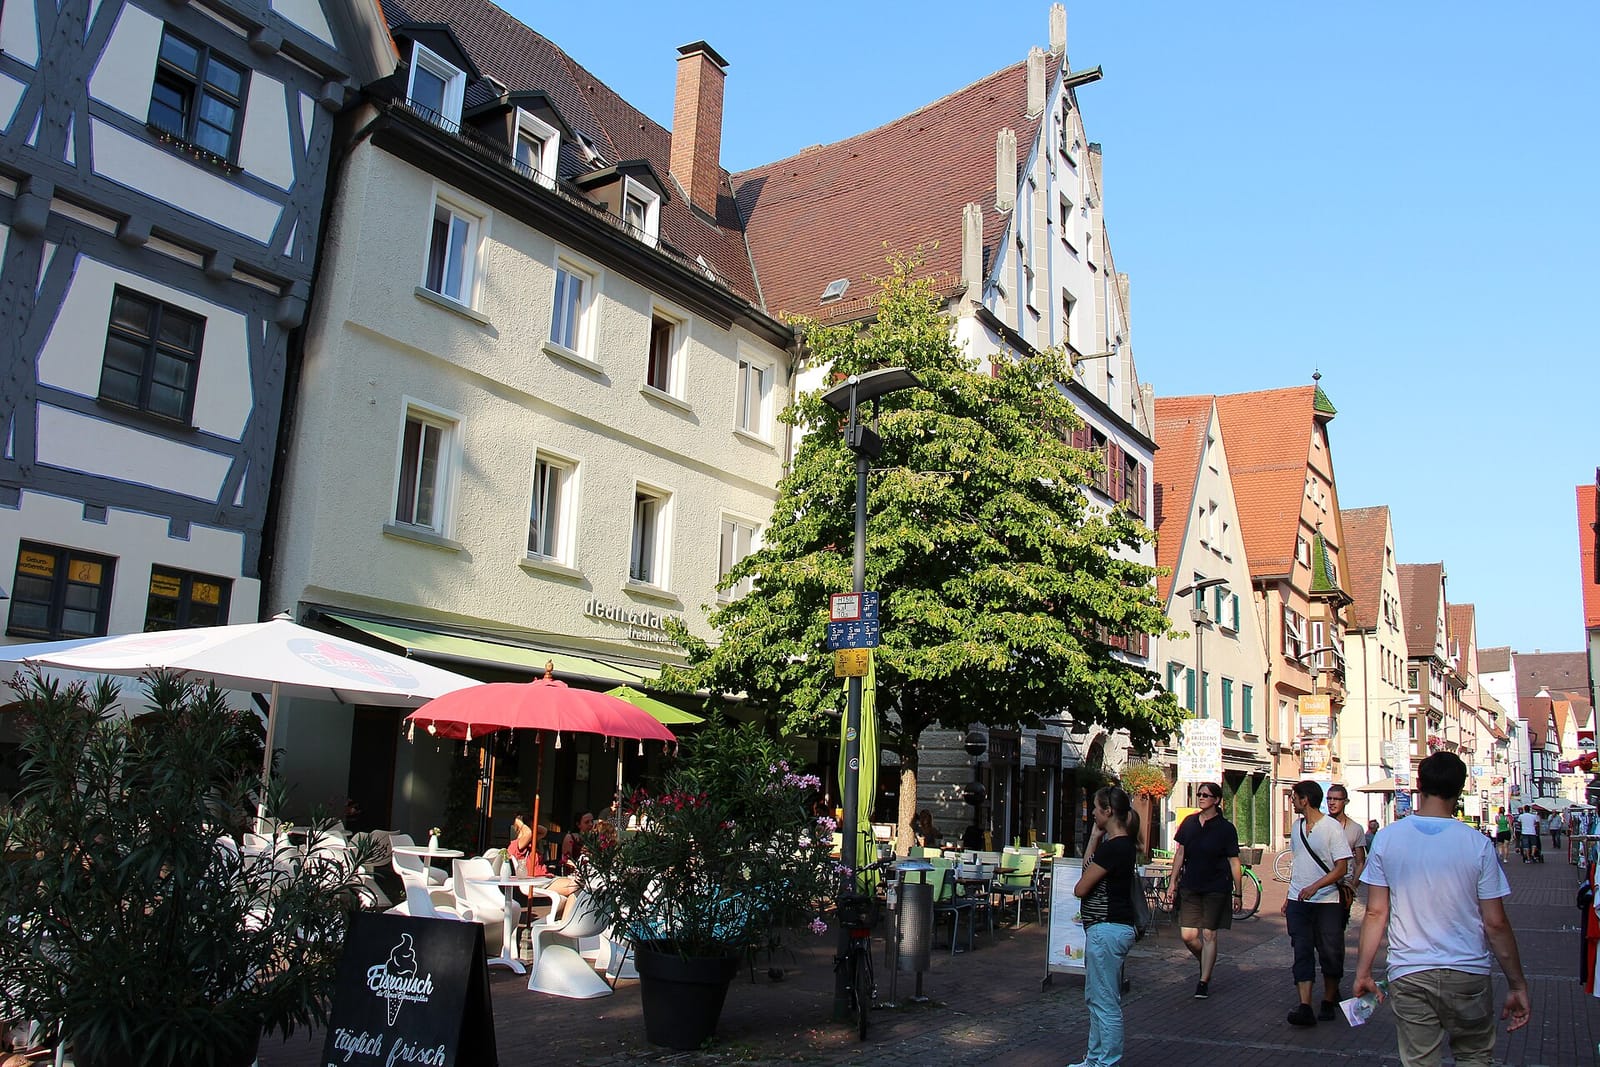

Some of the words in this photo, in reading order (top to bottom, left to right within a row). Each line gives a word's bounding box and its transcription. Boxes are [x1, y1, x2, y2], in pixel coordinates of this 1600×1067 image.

[366, 964, 434, 995] Eisrausch
[335, 1028, 384, 1063] täglich
[386, 1036, 446, 1067] frisch
